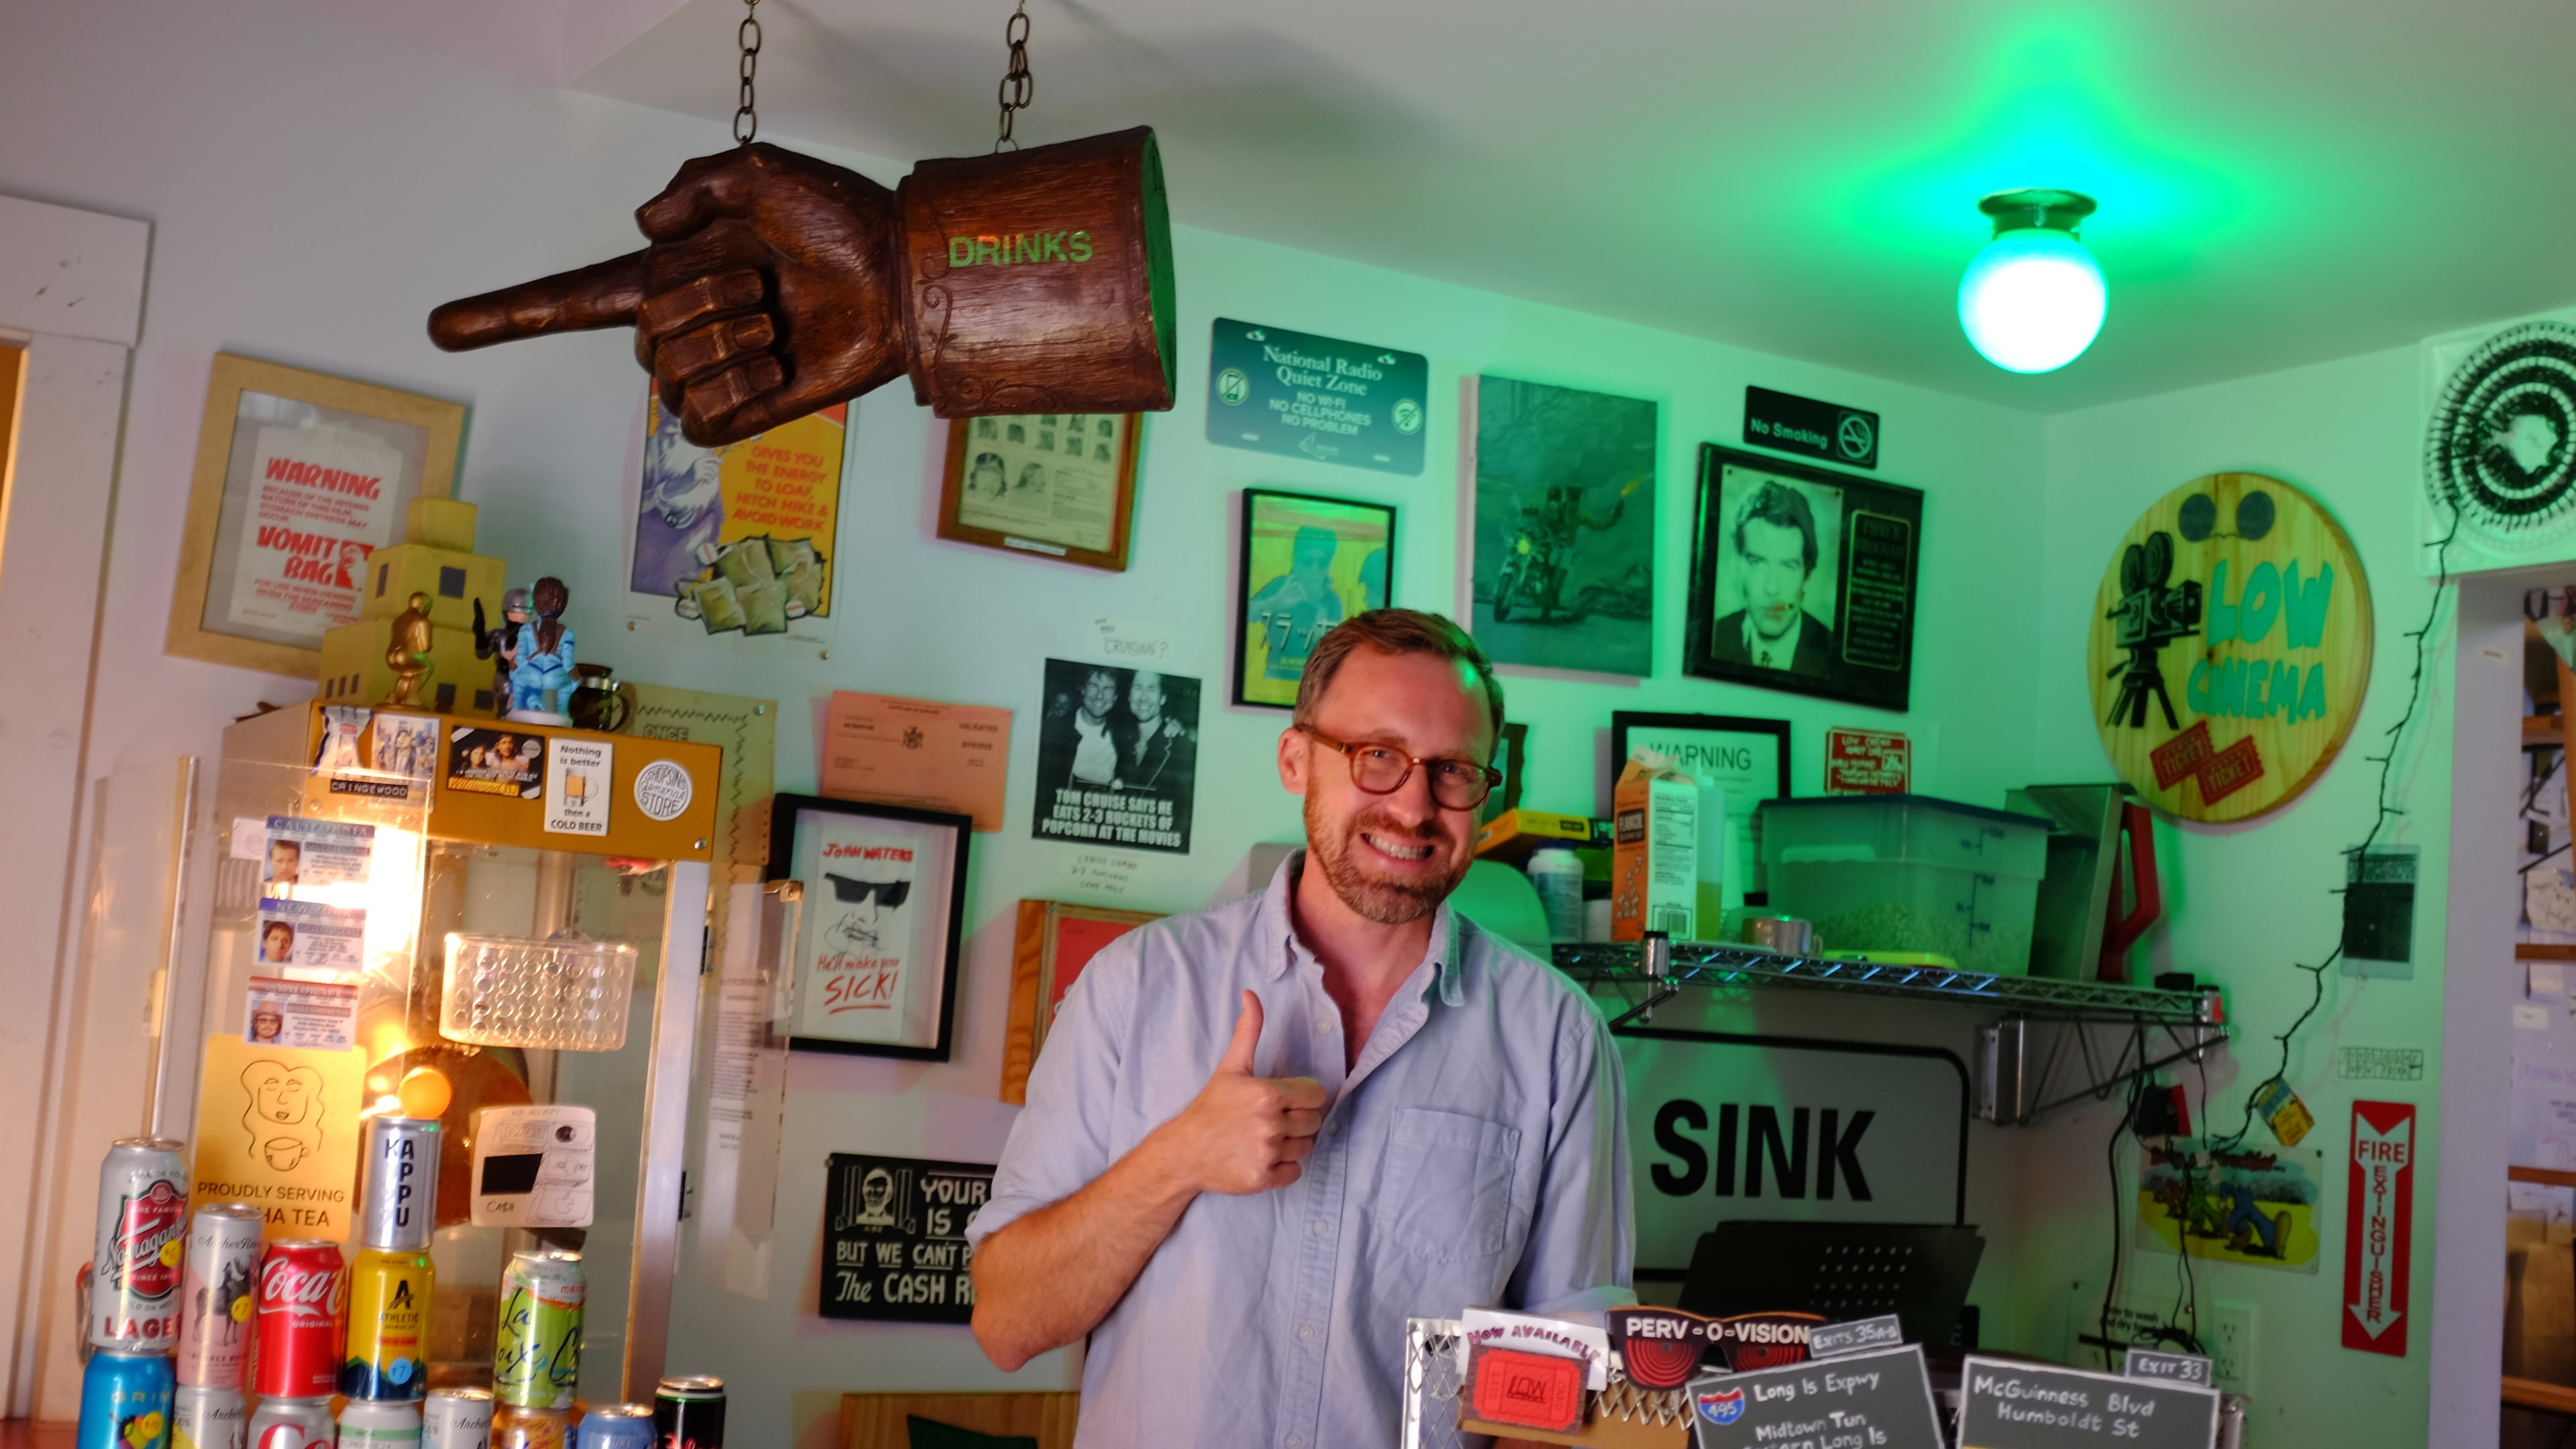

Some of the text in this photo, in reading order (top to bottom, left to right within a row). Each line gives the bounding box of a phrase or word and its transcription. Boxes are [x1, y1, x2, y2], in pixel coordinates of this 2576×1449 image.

[949, 231, 1093, 268] DRINKS
[1263, 345, 1383, 381] National Radio
[1277, 366, 1368, 396] Quiet Zone
[1269, 398, 1371, 427] NO CELLPHONES
[1296, 391, 1346, 410] NO WI-FI
[1281, 413, 1359, 436] NO PROBLEM
[1750, 417, 1829, 451] No Smoking
[751, 445, 824, 468] GIVES YOU
[266, 458, 382, 500] WARNING
[745, 460, 827, 484] THE ENERGY
[755, 478, 773, 492] TO
[735, 492, 777, 509] HITCH
[781, 499, 815, 515] HIKE
[347, 520, 368, 530] MAY
[732, 508, 825, 533] AVOID WORK
[257, 525, 339, 560] VOMIT
[283, 555, 334, 586] BAG
[2206, 557, 2334, 650] LOW
[2187, 656, 2326, 726] CINEMA
[958, 722, 999, 733] VALIDATED
[559, 757, 600, 768] is better
[560, 745, 602, 759] Nothing
[1650, 742, 1752, 771] WARNING
[2162, 739, 2206, 777] TICKET
[2207, 751, 2253, 791] TICKET
[331, 781, 407, 797] CRINGEWOOD
[641, 780, 686, 801] General
[1055, 788, 1173, 816] TOM CRUISE SAYS HE
[564, 808, 583, 818] then
[640, 791, 680, 816] STORE
[273, 818, 368, 837] CALIFORNIA
[550, 819, 602, 833] COLD BEER
[1053, 804, 1173, 831] EATS 2-3 BUCKETS OF
[1041, 817, 1182, 848] POPCORN AT THE MOVIES
[863, 845, 914, 864] WATERS
[844, 956, 878, 971] make
[878, 956, 900, 975] you
[824, 970, 899, 1006] SICK!
[1650, 1099, 1876, 1203] SINK
[2358, 1140, 2406, 1164] FIRE
[197, 1181, 345, 1203] PROUDLY SERVING
[920, 1178, 987, 1205] YOUR
[291, 1209, 330, 1227] TEA
[926, 1208, 953, 1236] IS
[836, 1242, 869, 1263] BUT
[875, 1242, 904, 1264] WE
[912, 1241, 959, 1267] CAN'T
[2366, 1166, 2388, 1324] EXTINGUISHER
[835, 1271, 873, 1303] The
[883, 1272, 947, 1305] CASH
[292, 1321, 333, 1329] ORIGINAL
[378, 1313, 419, 1323] ATHLETIC
[501, 1287, 531, 1338] La
[1467, 1324, 1601, 1363] NOW AVAILABLE
[1813, 1332, 1853, 1350] EXITS
[2137, 1357, 2204, 1381] EXIT 33
[1488, 1370, 1502, 1402] GIFT
[1509, 1375, 1549, 1397] LOW
[1554, 1381, 1567, 1411] CARD
[1754, 1371, 1880, 1403] Long Is Expwy
[1974, 1375, 2156, 1417] McGuinness Blvd
[1708, 1401, 1737, 1417] 495
[1997, 1401, 2141, 1438] Humboldt St
[1754, 1410, 1867, 1442] Midtown Tun
[1819, 1426, 1887, 1449] Long Is
